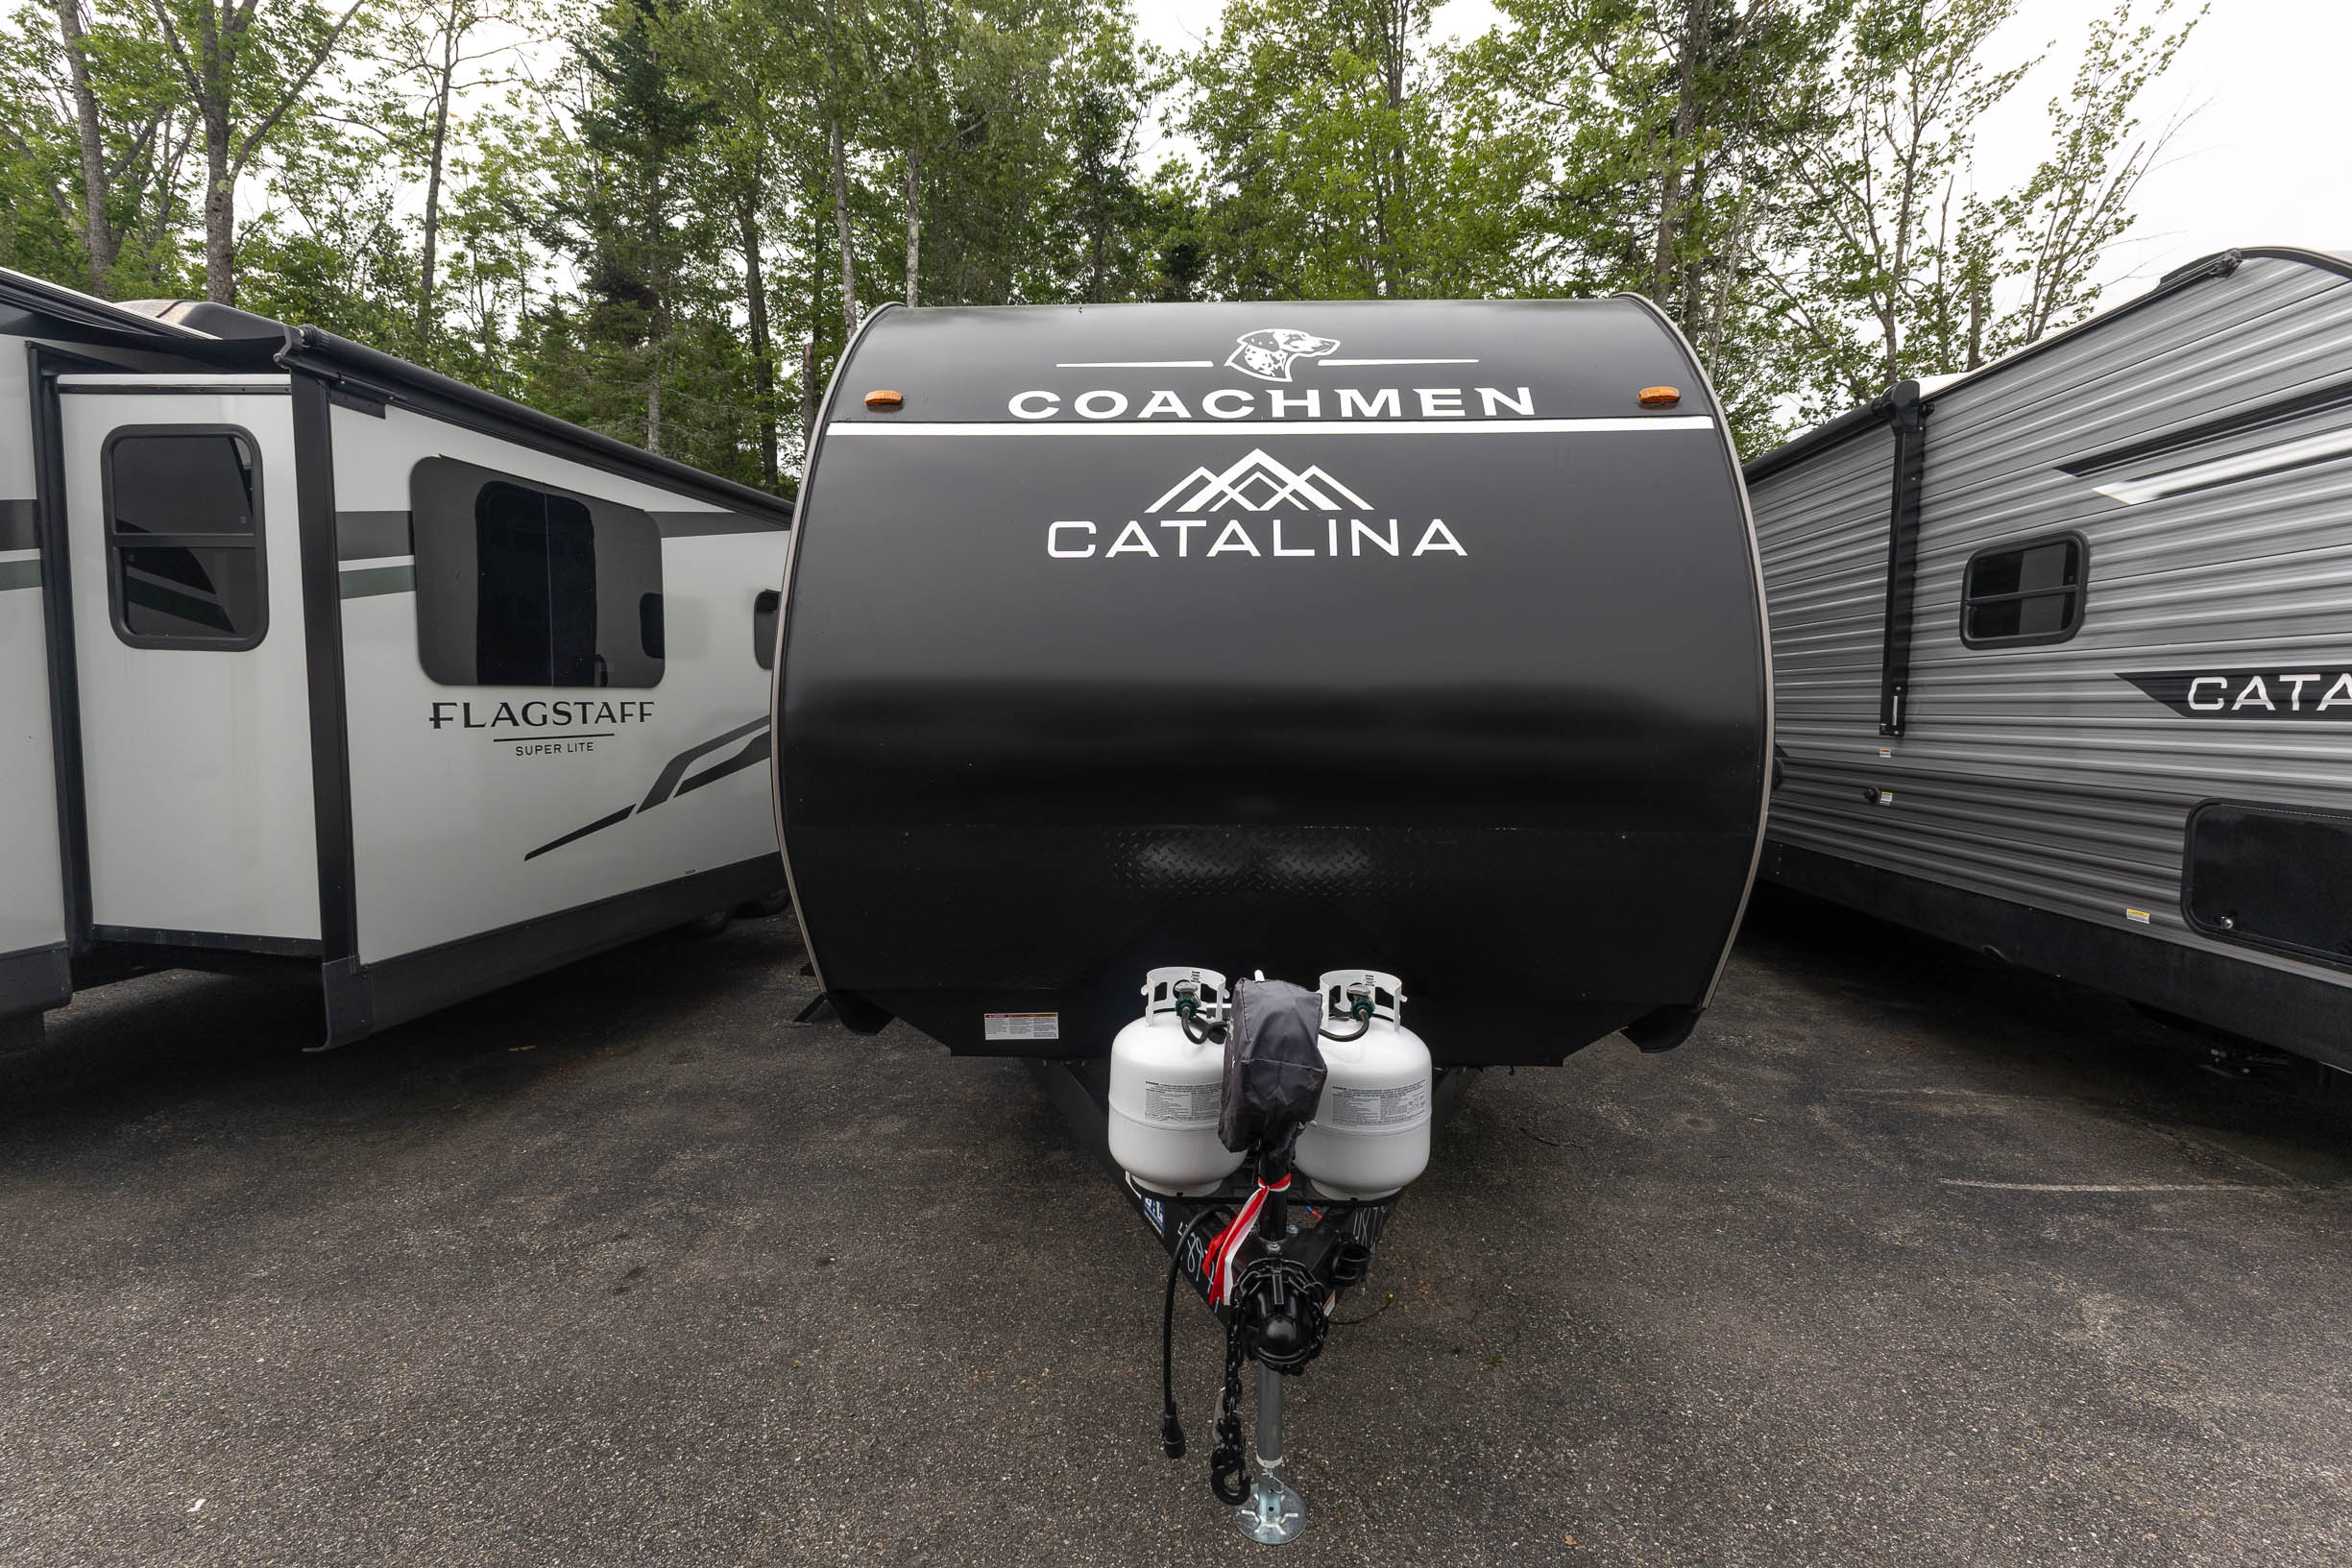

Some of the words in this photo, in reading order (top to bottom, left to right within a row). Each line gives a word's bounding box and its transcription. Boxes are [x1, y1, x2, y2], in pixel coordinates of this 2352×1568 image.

[1007, 386, 1537, 420] COACHMEN
[1047, 519, 1468, 559] CATALINA
[2187, 672, 2352, 712] CATA
[428, 700, 655, 730] FLAGSTAFF
[515, 743, 562, 757] SUPER
[568, 741, 594, 754] LITE
